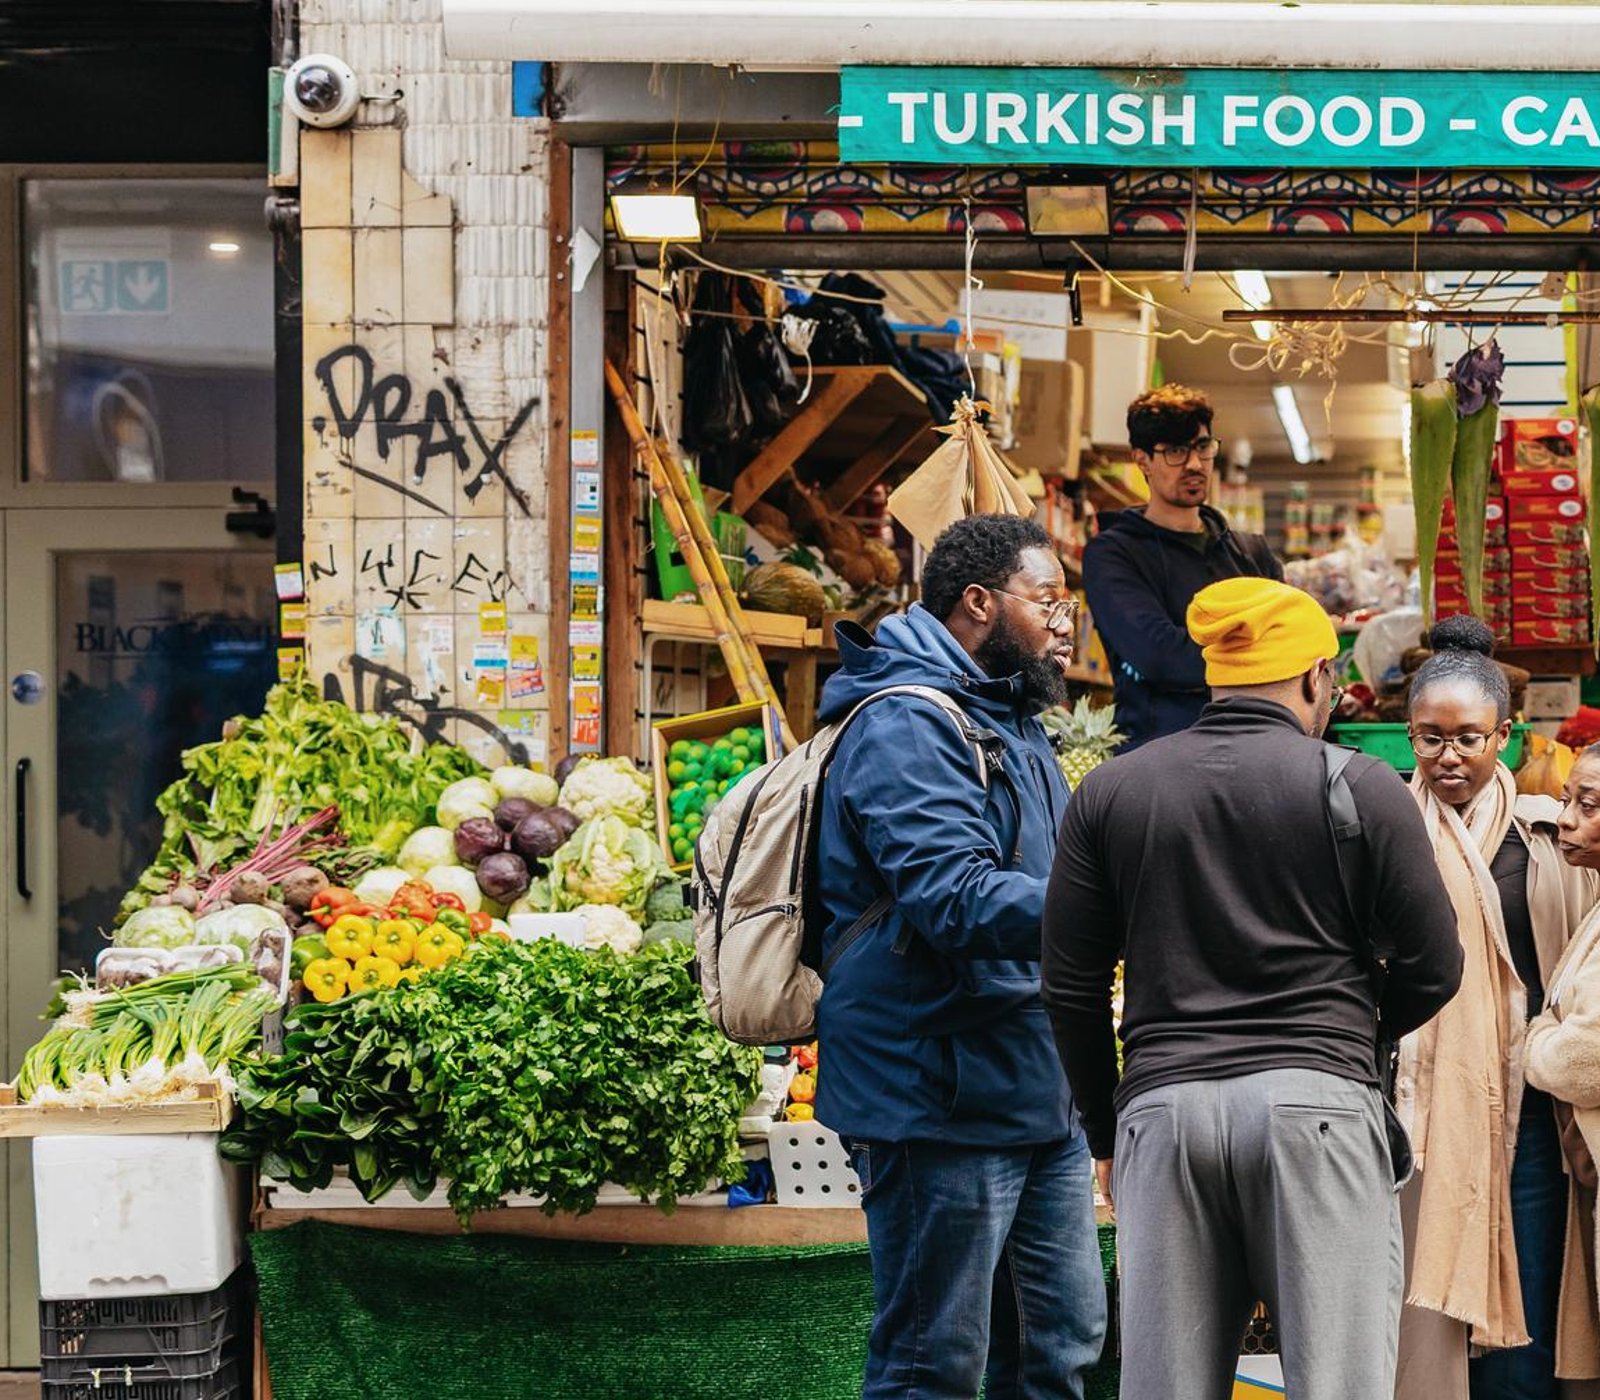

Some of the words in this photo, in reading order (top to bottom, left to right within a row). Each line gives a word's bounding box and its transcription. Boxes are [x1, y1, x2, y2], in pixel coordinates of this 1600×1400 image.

[889, 92, 1195, 145] TURKISH
[1224, 96, 1424, 147] FOOD
[316, 345, 541, 516] DRAX
